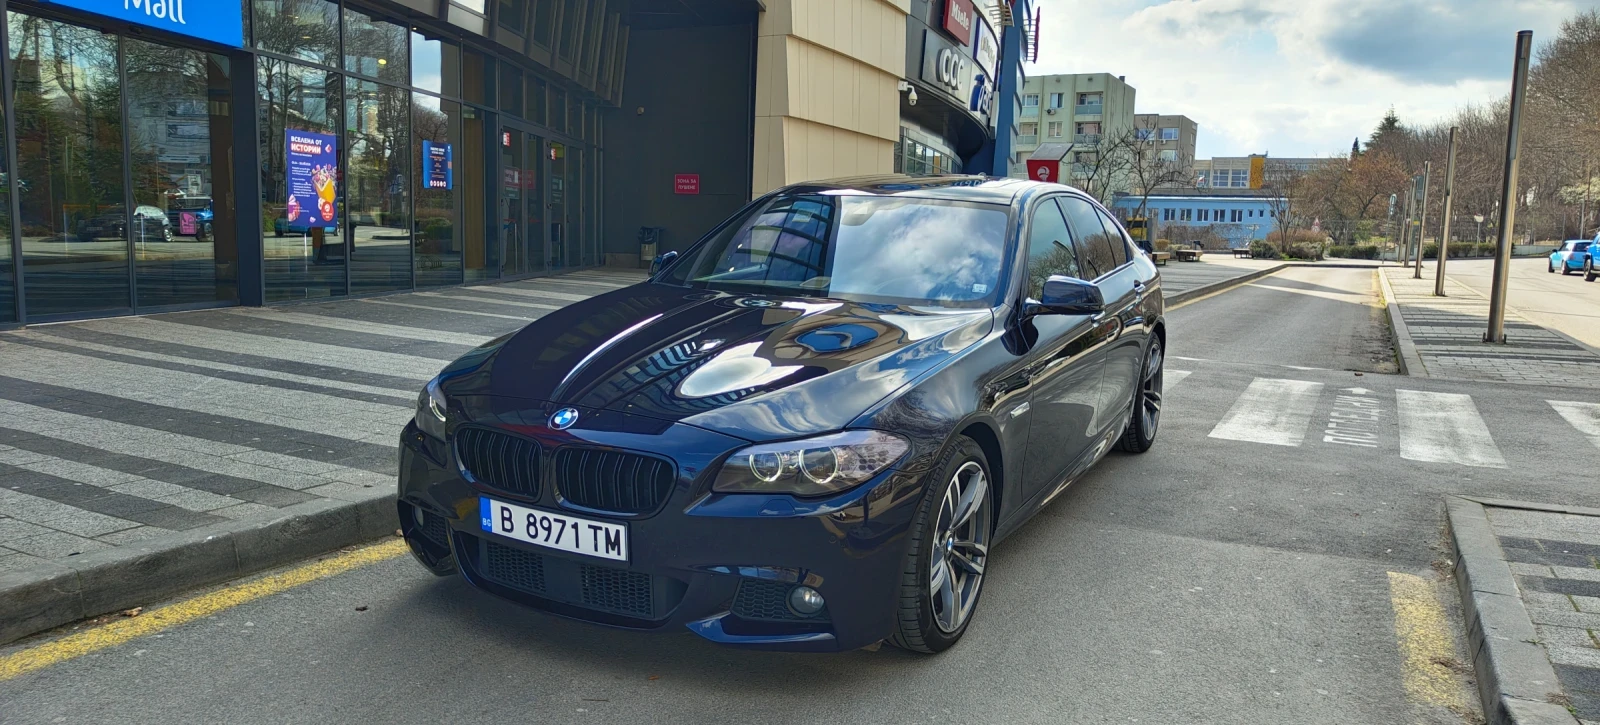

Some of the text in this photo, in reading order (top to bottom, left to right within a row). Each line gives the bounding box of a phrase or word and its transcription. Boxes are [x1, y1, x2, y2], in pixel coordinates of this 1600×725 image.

[951, 1, 970, 30] Miele
[938, 48, 965, 91] CCC
[290, 136, 314, 144] ВСЕЛЕНА
[290, 143, 322, 154] ИСТОРИИ
[482, 517, 492, 527] BG
[500, 505, 622, 557] B 8971 TM
